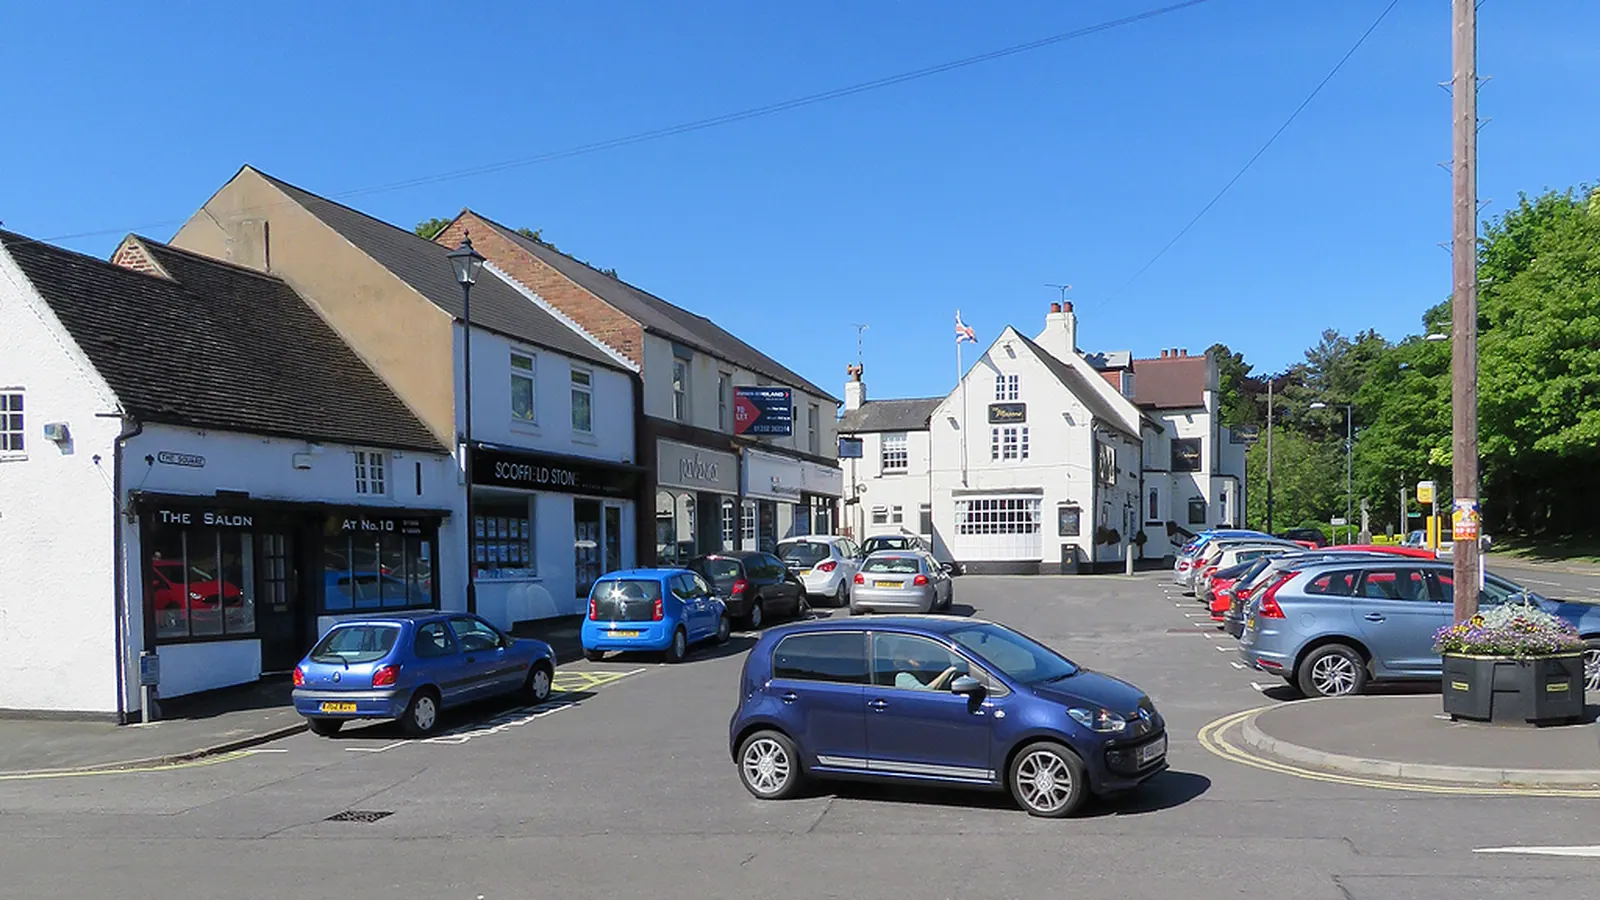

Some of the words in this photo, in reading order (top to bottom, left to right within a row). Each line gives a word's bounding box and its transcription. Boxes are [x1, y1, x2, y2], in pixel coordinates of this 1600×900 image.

[161, 453, 175, 462] THE
[178, 455, 203, 465] SQUARE
[160, 510, 191, 524] THE
[203, 512, 253, 526] SALON
[342, 519, 357, 530] AT
